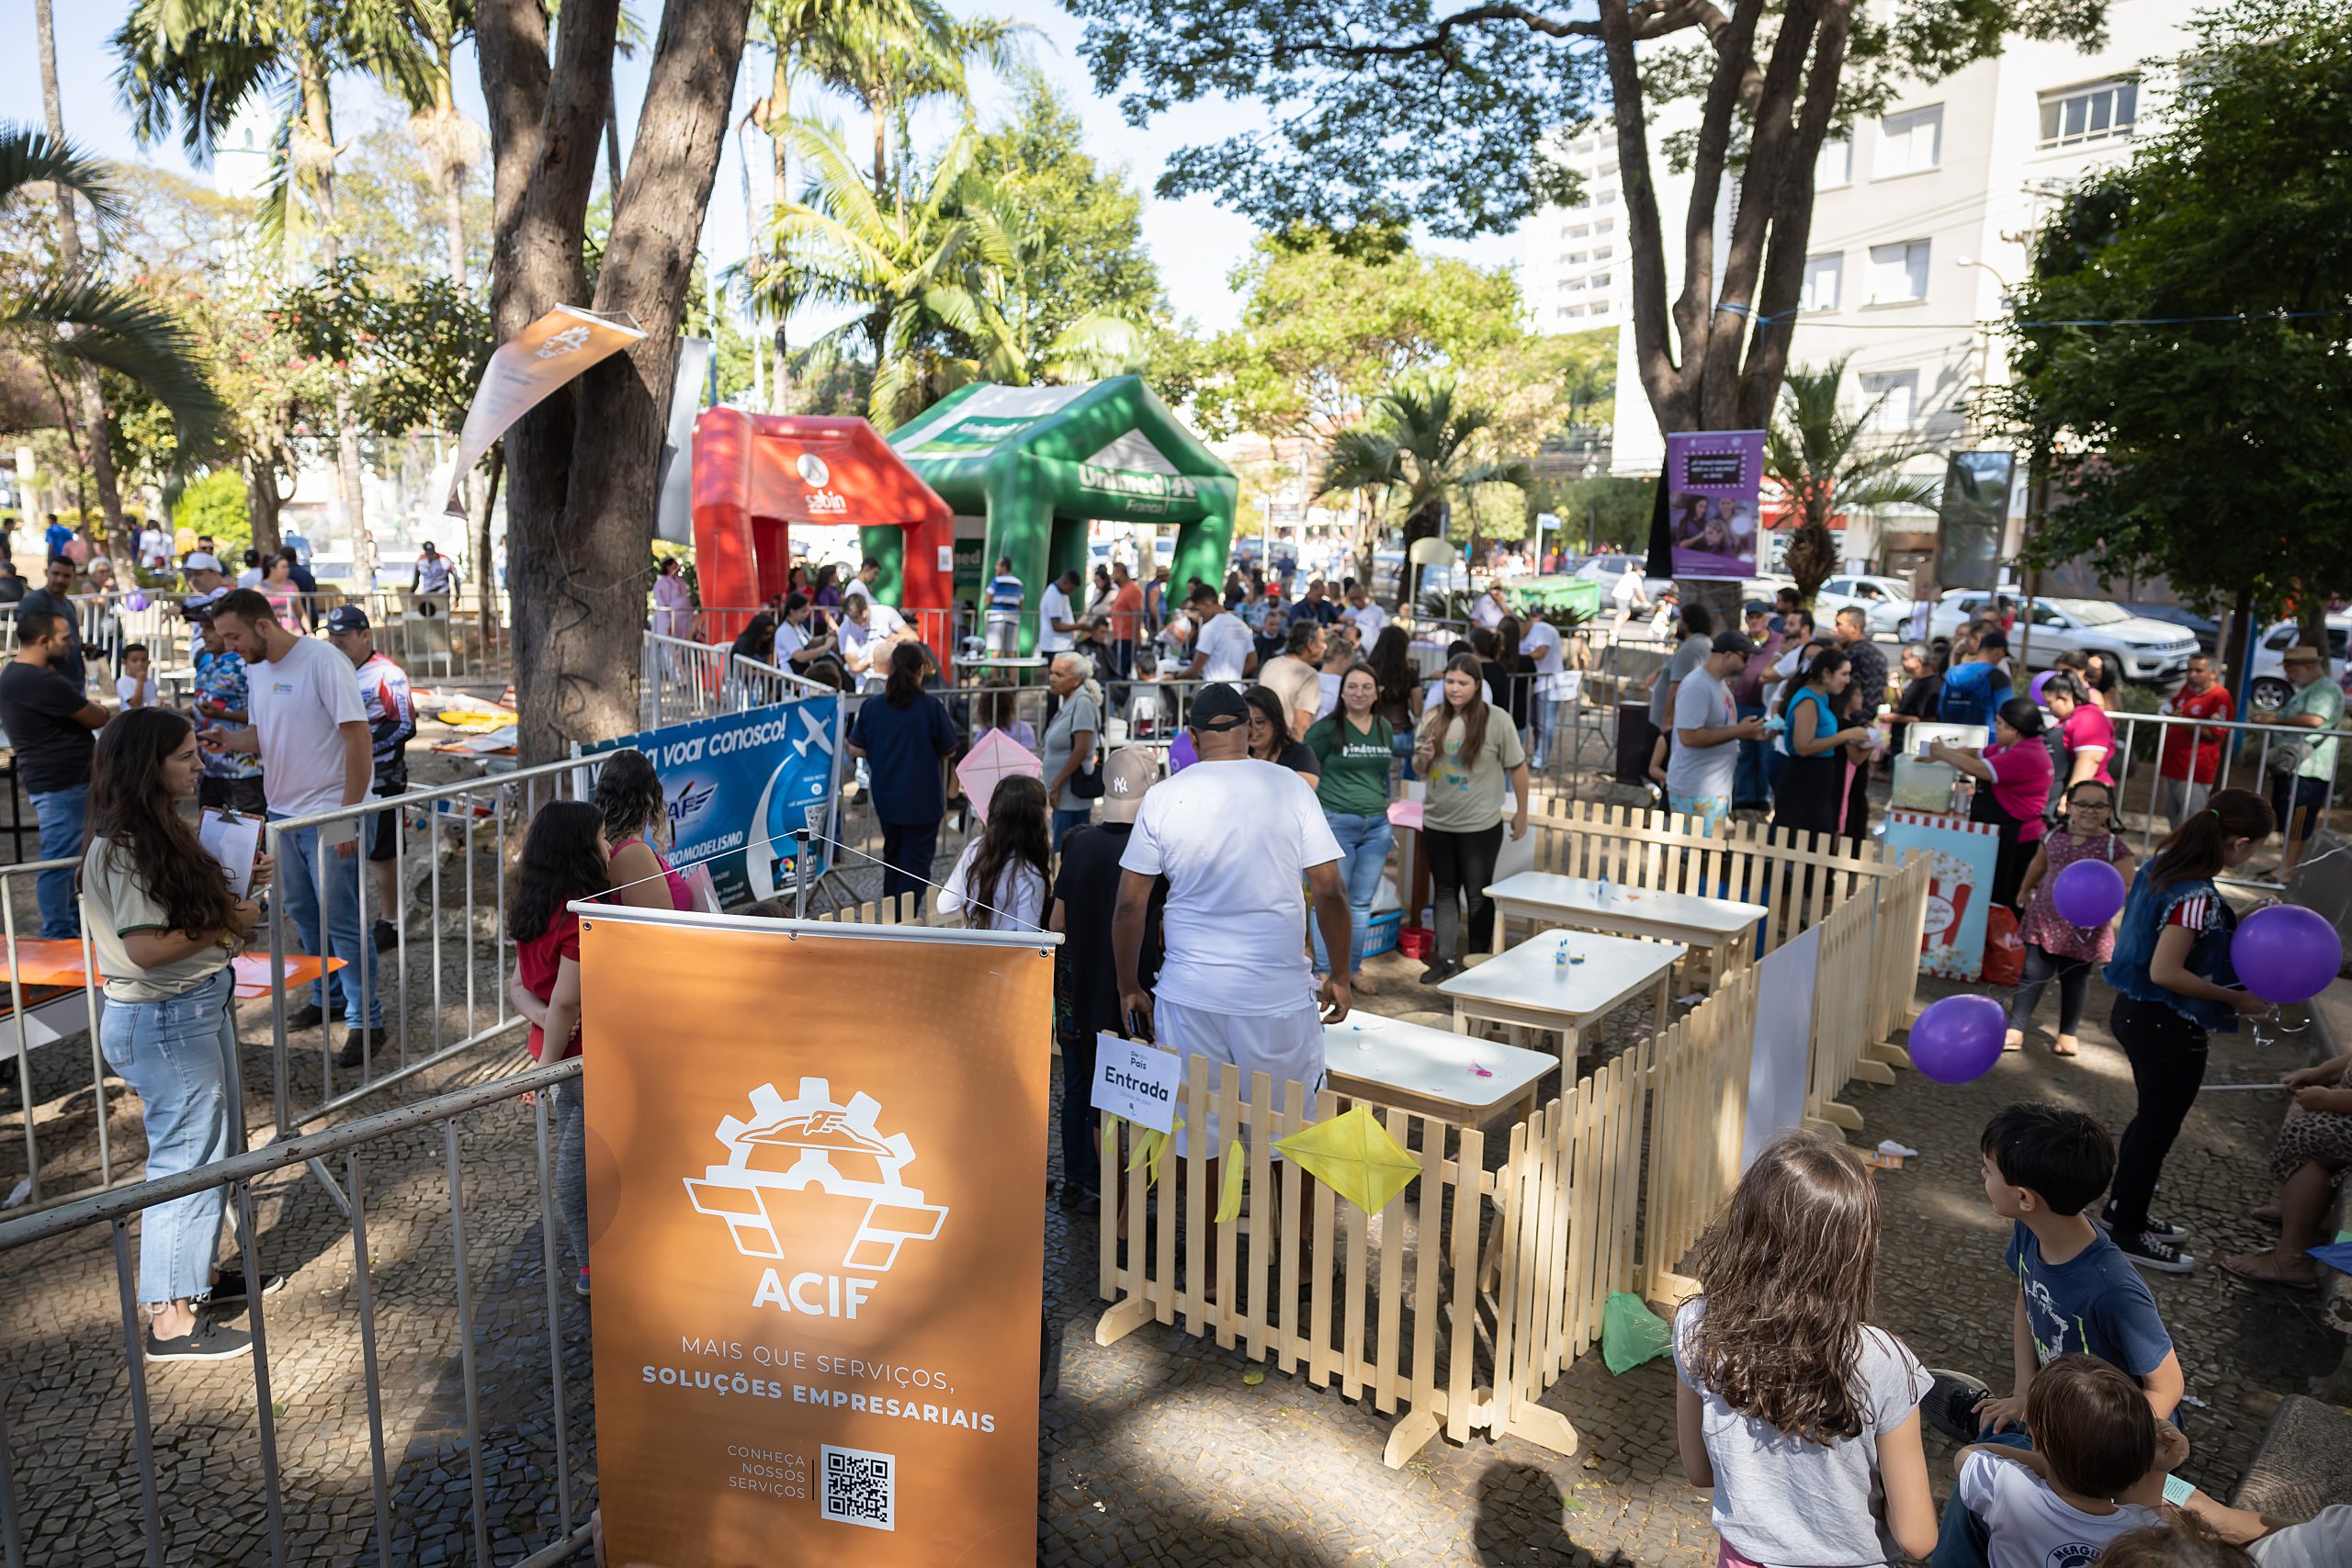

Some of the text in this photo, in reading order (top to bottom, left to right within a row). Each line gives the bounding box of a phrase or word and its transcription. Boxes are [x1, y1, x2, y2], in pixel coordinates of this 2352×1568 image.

[1078, 464, 1165, 496] Unimed
[805, 489, 847, 509] sabin
[662, 736, 706, 767] voar
[708, 712, 787, 757] conosco!
[1114, 776, 1128, 793] NY
[663, 830, 743, 866] ROMODELISMO
[1130, 1057, 1147, 1070] Pais
[1104, 1066, 1169, 1102] Entrada
[752, 1268, 877, 1320] ACIF
[681, 1336, 956, 1394] MAIS QUE SERVIÇOS,
[642, 1365, 996, 1433] SOLUÇÕES EMPRESARIAIS
[727, 1445, 806, 1468] CONHEÇA
[742, 1462, 806, 1483] NOSSOS
[728, 1476, 806, 1499] SERVIÇOS
